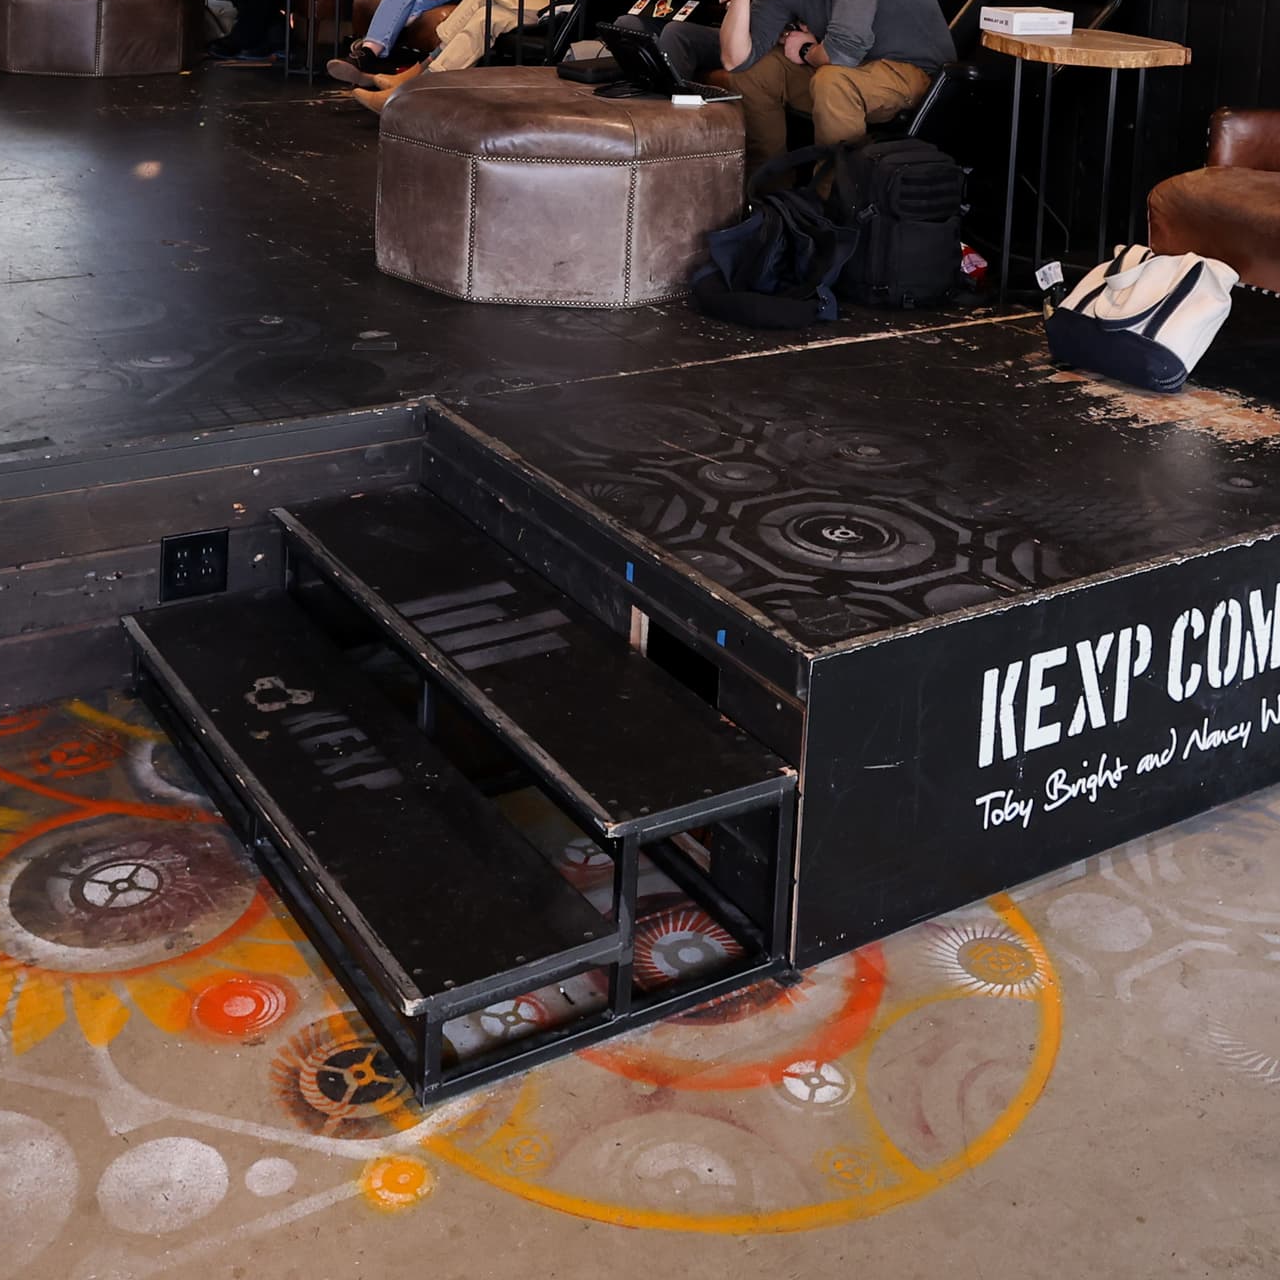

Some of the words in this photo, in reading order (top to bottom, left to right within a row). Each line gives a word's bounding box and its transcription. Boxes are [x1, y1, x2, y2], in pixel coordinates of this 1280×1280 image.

[280, 711, 404, 791] KEXP
[978, 623, 1153, 768] KEXP
[975, 789, 1034, 830] Toby
[1043, 752, 1128, 812] Bright
[1136, 728, 1177, 775] and
[1183, 717, 1252, 760] Nancy
